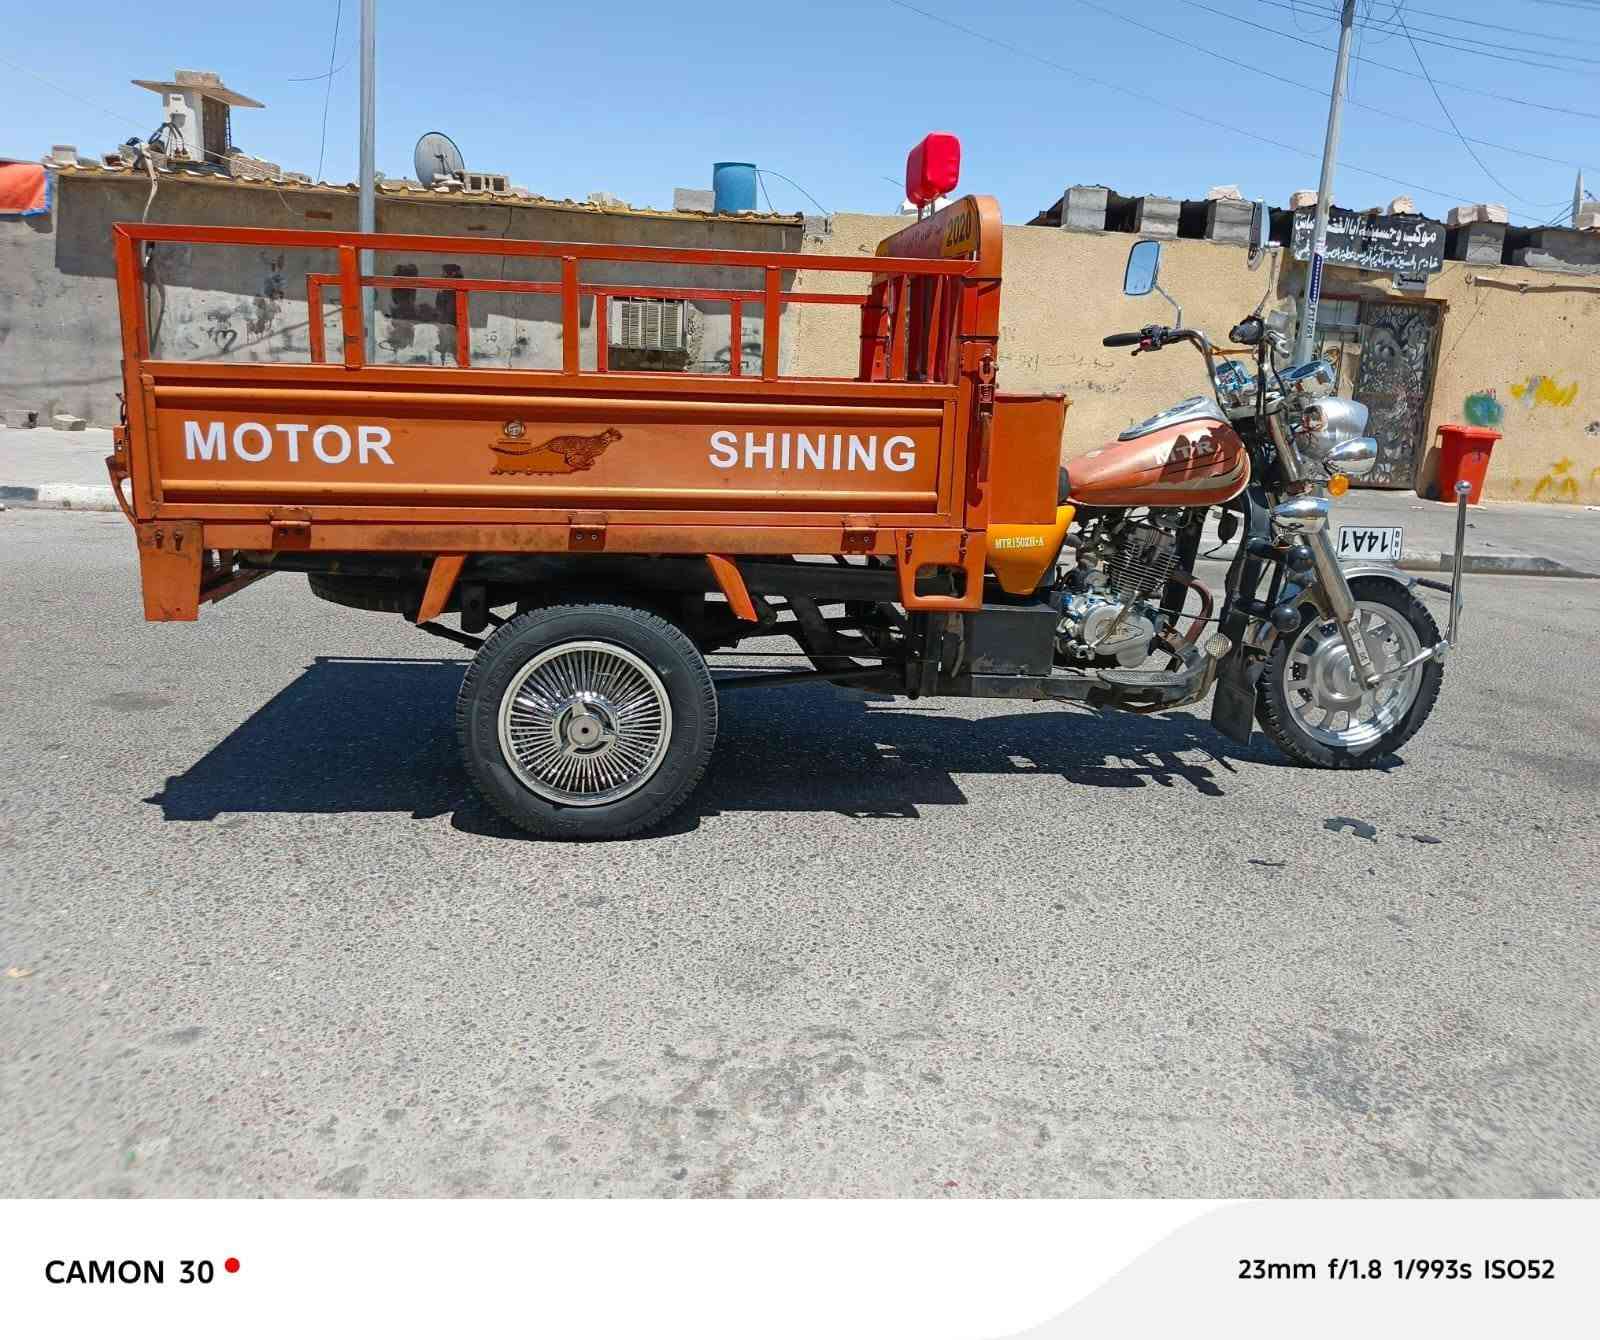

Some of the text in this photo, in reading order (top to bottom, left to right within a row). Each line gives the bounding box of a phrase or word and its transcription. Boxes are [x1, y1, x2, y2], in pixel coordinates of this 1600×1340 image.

[944, 212, 972, 247] 2020
[1403, 223, 1436, 247] موكب
[184, 420, 395, 465] MOTOR
[708, 430, 917, 473] SHINING
